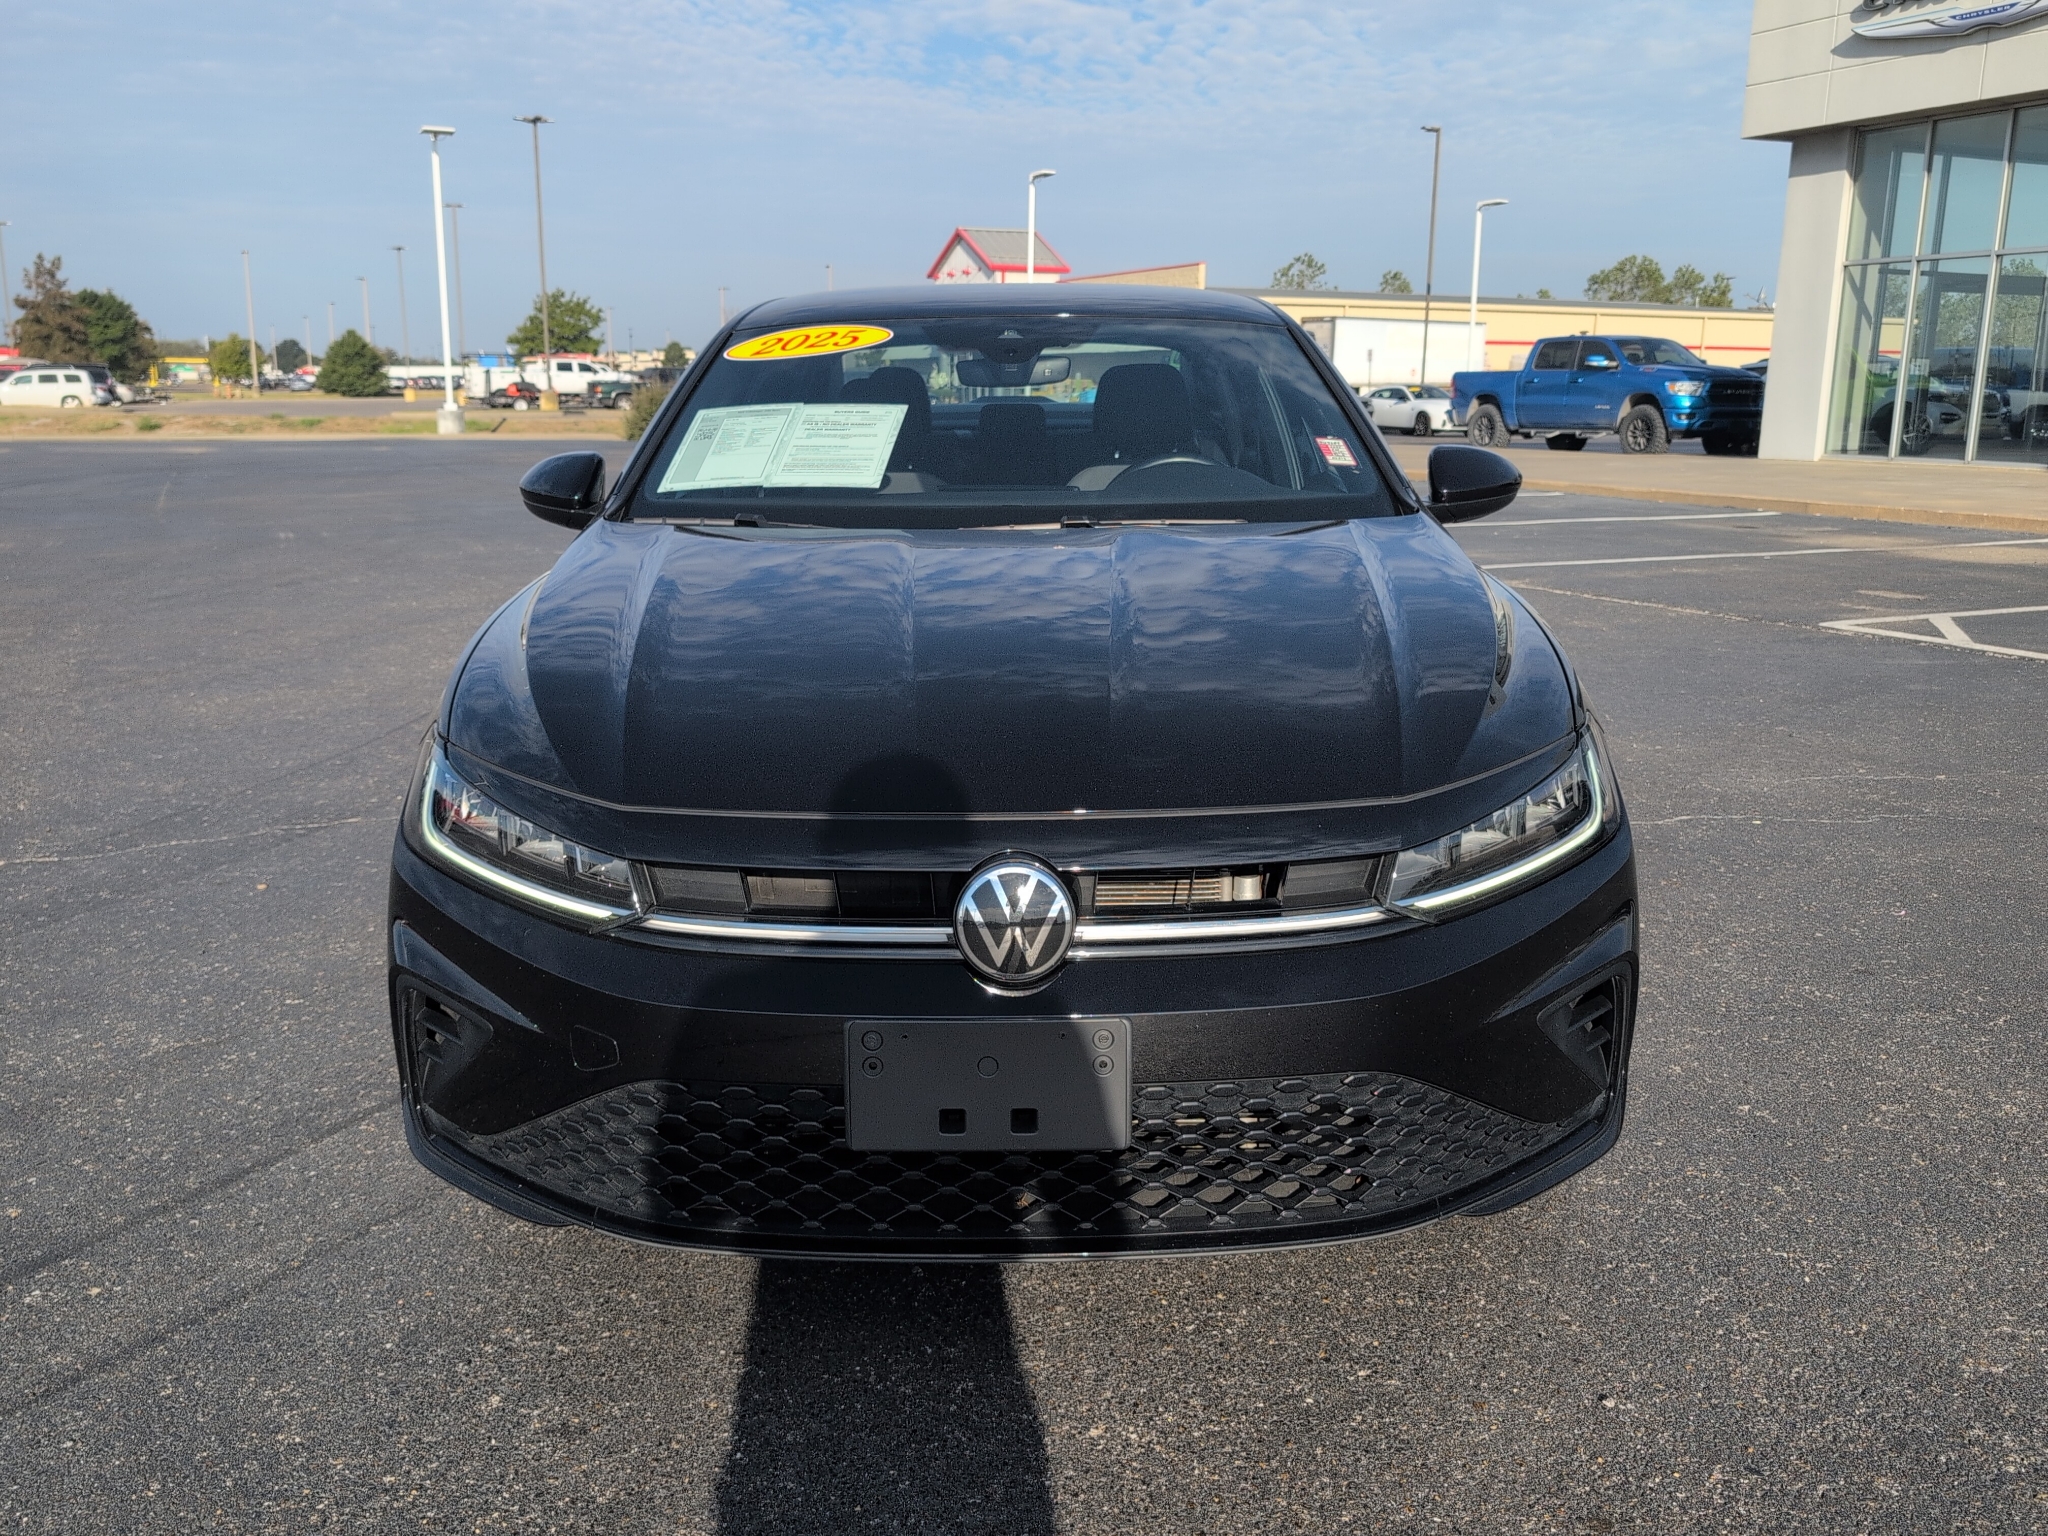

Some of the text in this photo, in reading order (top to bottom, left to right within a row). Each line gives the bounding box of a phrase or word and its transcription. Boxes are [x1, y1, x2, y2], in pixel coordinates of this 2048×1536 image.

[1955, 5, 2011, 20] CHRYSLER
[749, 329, 867, 357] 2025
[958, 863, 1072, 976] VW
